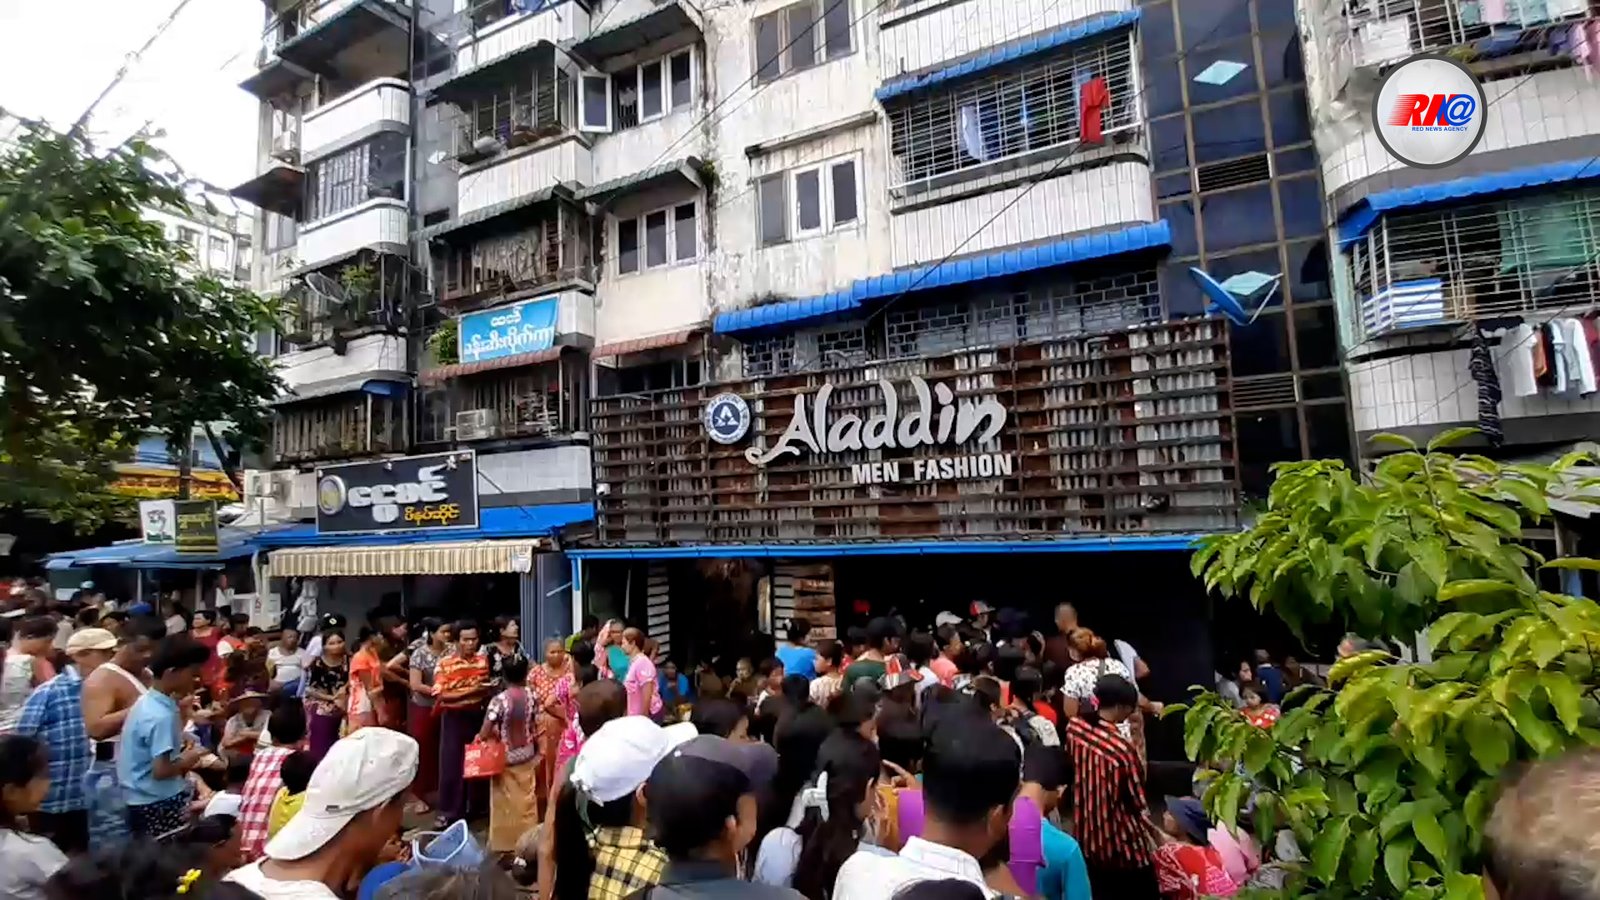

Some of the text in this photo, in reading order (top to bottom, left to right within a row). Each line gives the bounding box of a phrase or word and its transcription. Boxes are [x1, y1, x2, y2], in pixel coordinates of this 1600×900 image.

[745, 377, 1007, 465] Aladdin
[852, 453, 1012, 484] MEN FASHION
